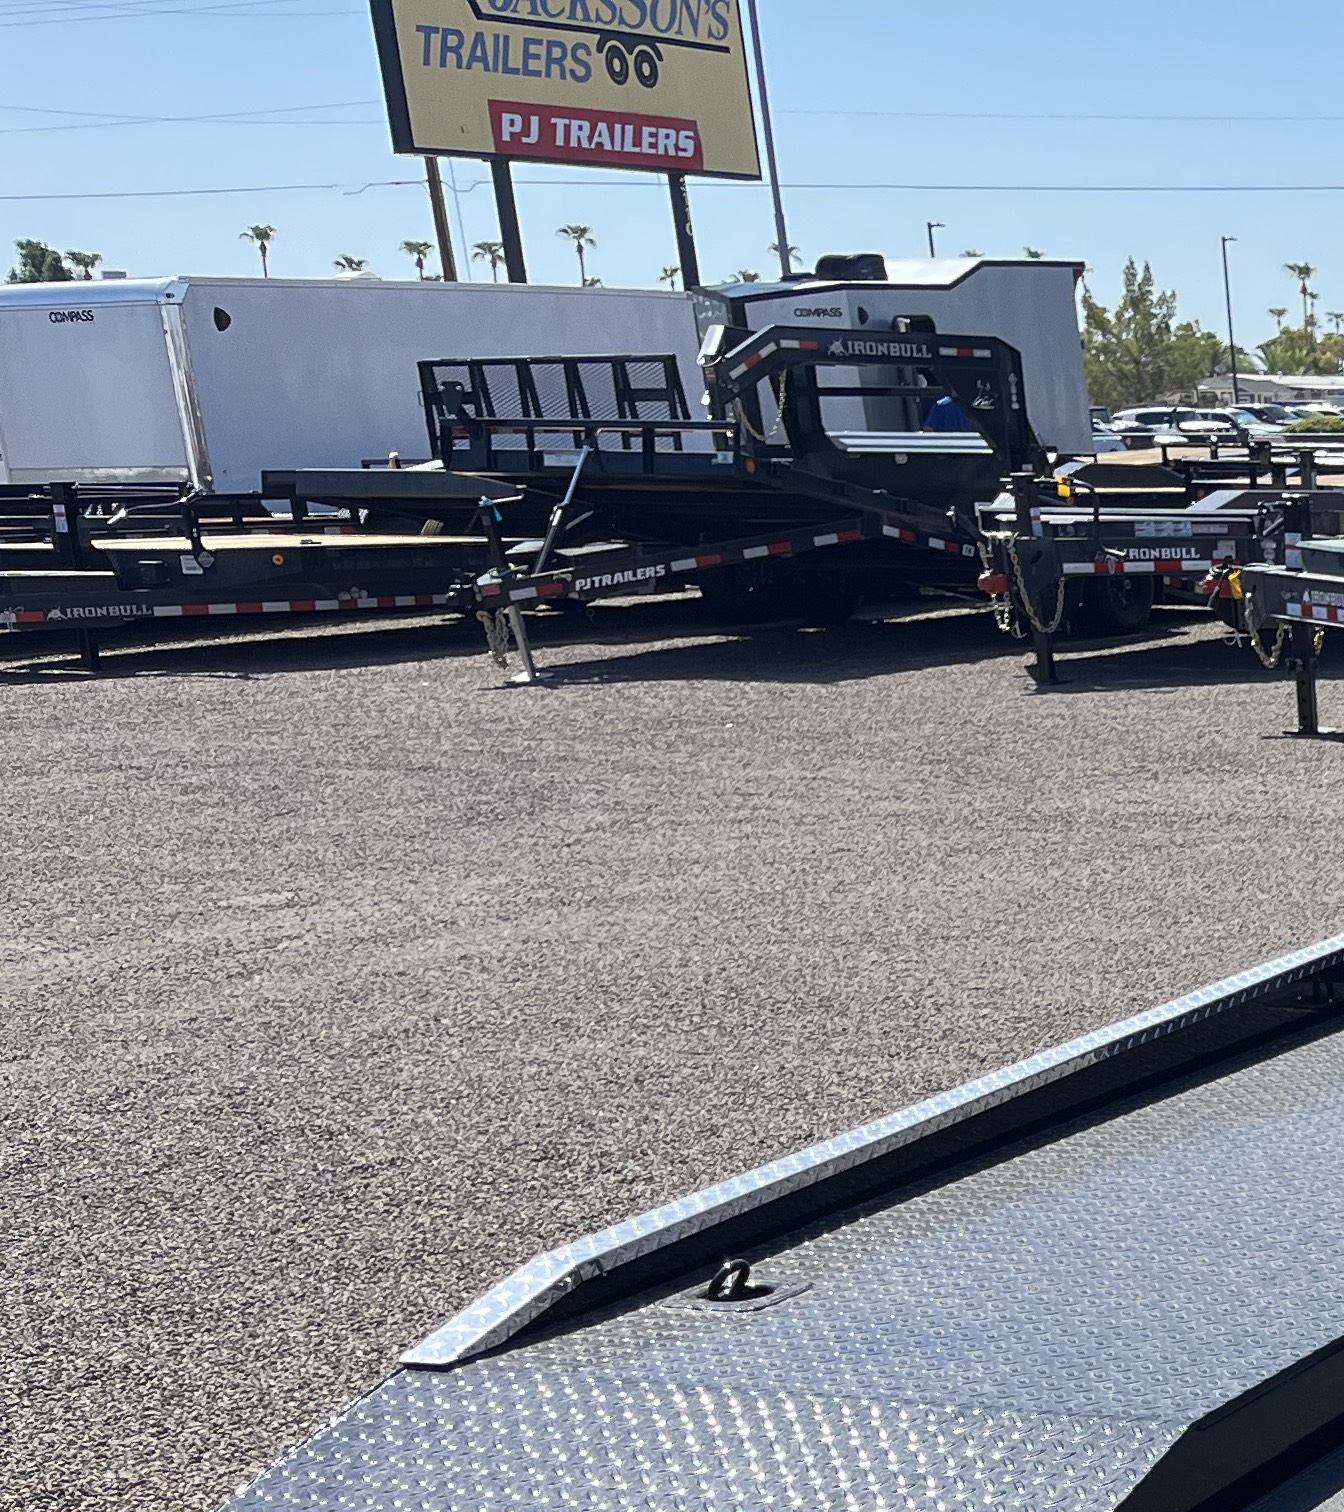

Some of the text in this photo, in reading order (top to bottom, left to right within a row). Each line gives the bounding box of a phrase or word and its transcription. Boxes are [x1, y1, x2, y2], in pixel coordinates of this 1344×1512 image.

[490, 0, 730, 41] KSSON'S
[416, 25, 593, 84] TRAILERS
[501, 112, 695, 158] PJ TRAILERS
[48, 310, 95, 323] COMPASS
[793, 307, 843, 318] COMPASS
[848, 341, 932, 358] IRONBULL
[1123, 547, 1201, 560] RONBULL
[66, 604, 153, 619] IRONBULL
